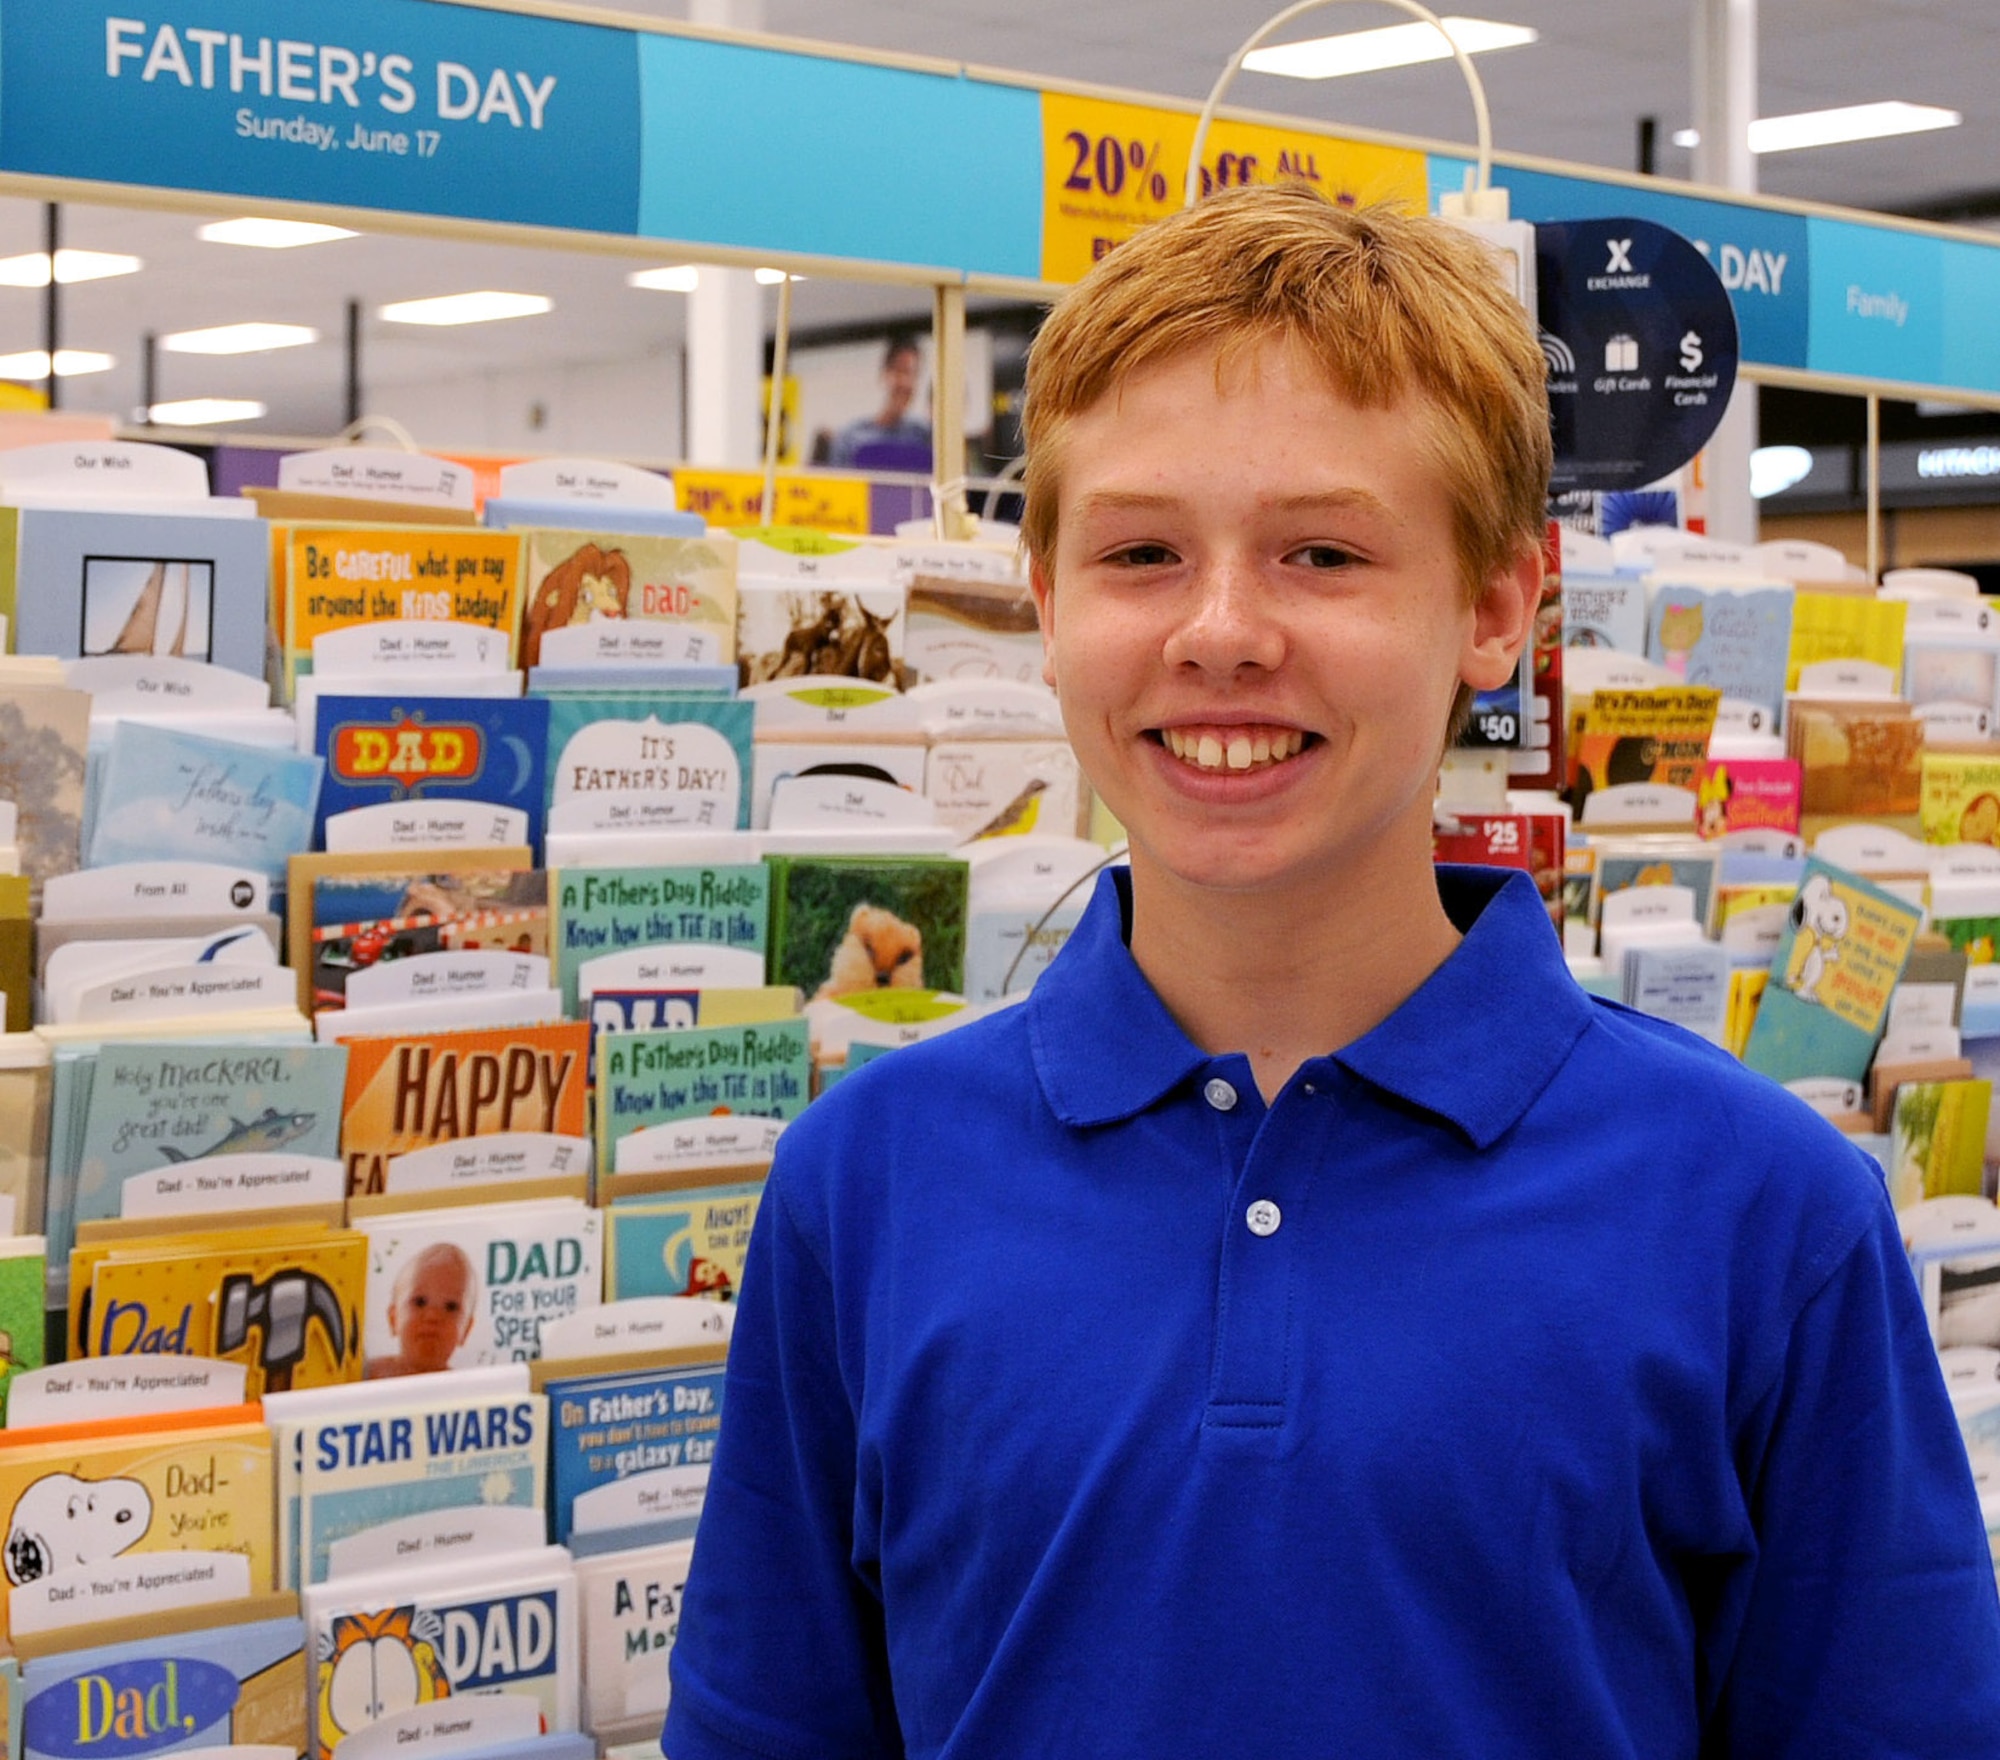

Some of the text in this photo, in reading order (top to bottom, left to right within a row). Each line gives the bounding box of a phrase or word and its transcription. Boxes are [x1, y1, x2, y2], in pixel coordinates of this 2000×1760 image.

[105, 17, 556, 131] FATHER'S DAY
[235, 108, 441, 158] Sunday, June 17
[1064, 131, 1166, 202] 20%
[1277, 150, 1321, 181] ALL
[1605, 238, 1633, 273] X
[1586, 274, 1651, 292] EXCHANGE
[1719, 244, 1788, 296] DAY
[1846, 284, 1910, 328] Family
[1593, 376, 1617, 394] Gift
[1618, 376, 1651, 392] Cards
[1664, 373, 1719, 390] Financial
[1673, 391, 1709, 407] Cards
[74, 455, 132, 470] Our Wish
[331, 464, 403, 480] Dad Humor
[556, 473, 577, 488] Dad
[306, 545, 505, 584] Be CAREFUL what you say
[308, 588, 367, 619] around
[371, 589, 397, 616] the
[455, 589, 509, 629] today!
[379, 636, 450, 651] Dad Humor
[598, 636, 663, 650] Dad Humor
[135, 677, 192, 696] Our Wish
[1479, 714, 1516, 742] $50
[352, 730, 466, 773] DAD
[641, 735, 675, 761] IT'S
[572, 765, 728, 792] FATHER'S DAY!
[393, 819, 465, 833] Dad Humor
[609, 804, 675, 820] Dad Humor
[1483, 819, 1519, 847] $25
[134, 883, 188, 898] From All
[562, 885, 577, 910] A
[583, 874, 660, 913] Father's
[663, 878, 697, 907] Day
[566, 918, 609, 949] Know
[611, 916, 641, 947] how
[645, 910, 673, 941] this
[709, 918, 723, 940] is
[727, 911, 757, 946] like
[412, 969, 486, 986] Dad Humor
[638, 964, 705, 979] Dad Humor
[111, 976, 263, 1002] Dad You're Appreciated
[610, 1052, 625, 1075] A
[631, 1040, 705, 1078] Father's
[708, 1040, 740, 1066] Day
[113, 1065, 154, 1096] Holy
[393, 1046, 572, 1141] HAPPY
[148, 1091, 230, 1119] you're one
[614, 1084, 655, 1115] Know
[660, 1081, 687, 1110] how
[751, 1078, 766, 1099] is
[112, 1118, 168, 1154] great
[675, 1134, 739, 1150] Dad Humor
[453, 1152, 526, 1169] Dad Humor
[156, 1169, 312, 1195] Dad You're Appreciated
[346, 1152, 406, 1199] FA
[490, 1285, 578, 1317] FOR YOUR
[595, 1320, 664, 1338] Dad Humor
[45, 1373, 211, 1394] Dad You're Appreciated
[560, 1384, 715, 1429] On Father's Day,
[315, 1402, 534, 1473] STAR WARS
[578, 1433, 606, 1453] you
[614, 1441, 682, 1480] galaxy
[165, 1455, 230, 1499] Dad-
[638, 1490, 660, 1506] Dad
[169, 1509, 230, 1538] You're
[396, 1531, 475, 1555] Dad Humor
[48, 1566, 216, 1603] Dad You're Appreciated
[615, 1579, 635, 1618] A
[442, 1597, 554, 1685] DAD
[73, 1659, 196, 1747] Dad,
[396, 1718, 473, 1744] Dad Humor
